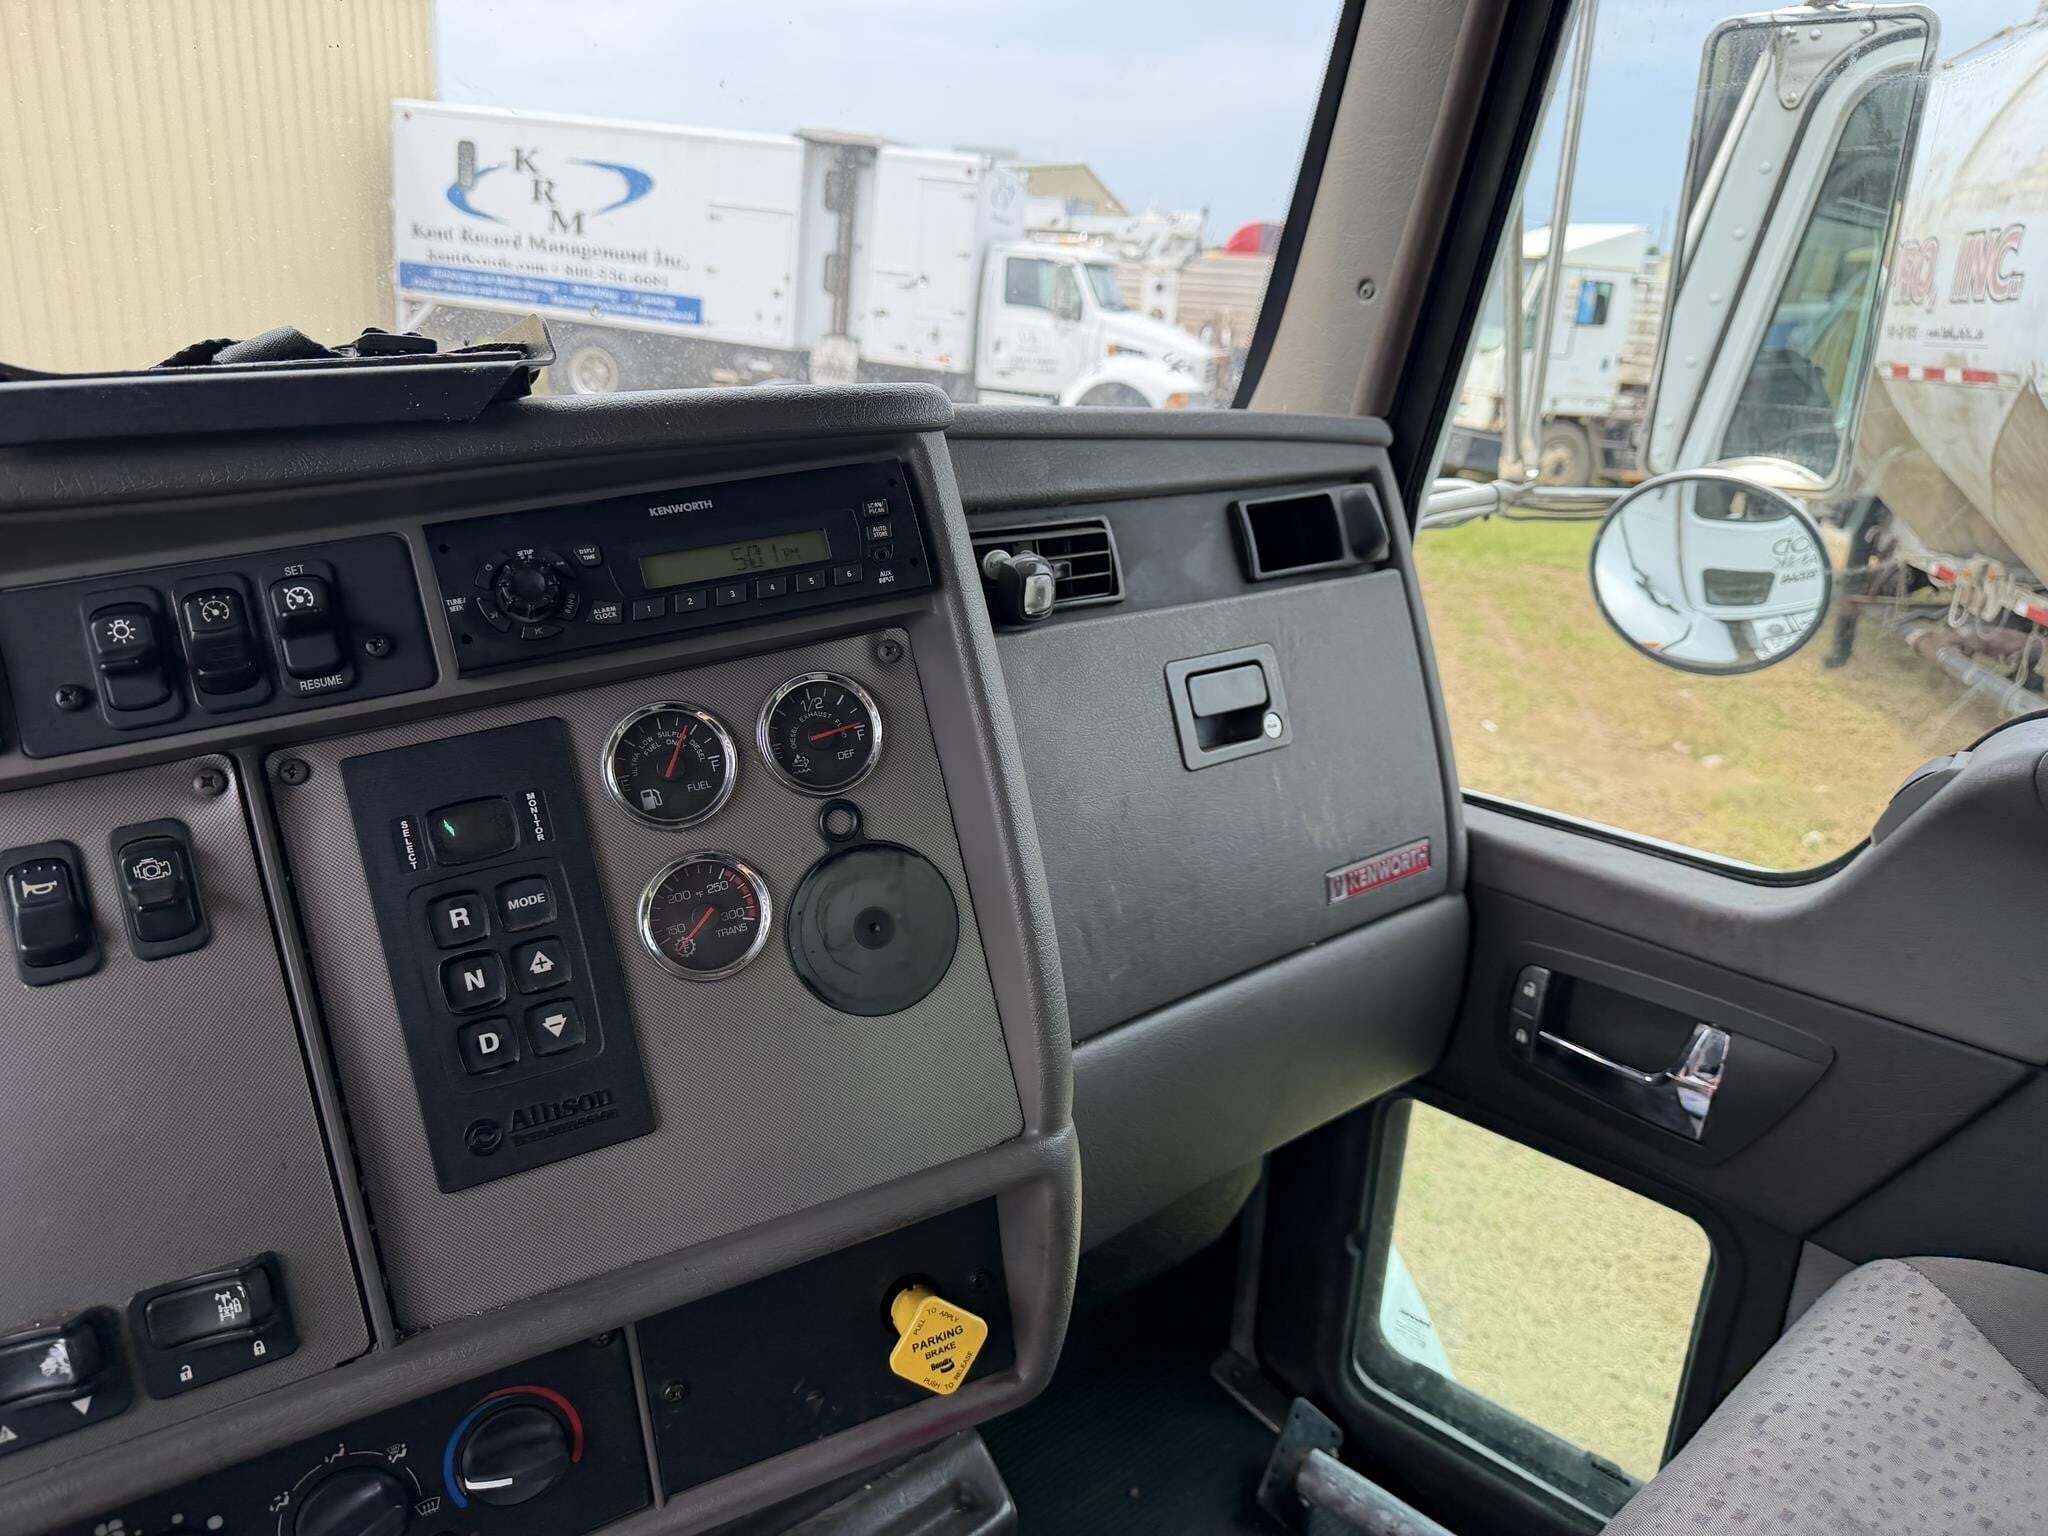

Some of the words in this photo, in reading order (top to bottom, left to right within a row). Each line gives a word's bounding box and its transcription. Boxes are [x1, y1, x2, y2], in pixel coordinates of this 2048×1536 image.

[513, 147, 540, 175] K
[549, 210, 586, 236] M
[649, 499, 713, 517] KENWORTH
[872, 525, 887, 533] AUTO
[517, 549, 534, 557] SETUP
[284, 564, 305, 577] SET
[846, 570, 852, 578] 6
[770, 583, 775, 591] 4
[809, 577, 815, 585] 5
[878, 576, 894, 584] INPUT
[730, 590, 736, 598] 3
[593, 606, 617, 614] ALARM
[595, 612, 617, 621] CLOCK
[300, 674, 344, 692] RESUME
[799, 712, 832, 723] EXHAUST
[856, 729, 865, 741] F
[631, 752, 640, 777] ULTRA
[640, 735, 653, 749] LOW
[688, 740, 706, 762] DIESEL
[644, 741, 662, 756] FUEL
[837, 748, 855, 760] DEF
[711, 760, 721, 772] F
[687, 780, 713, 792] FUEL
[526, 791, 546, 842] MONITOR
[400, 820, 417, 870] SELECT
[1347, 845, 1430, 891] KENWORTH
[667, 889, 692, 904] 200
[706, 880, 730, 895] 250
[508, 892, 546, 911] MODE
[449, 907, 471, 929] R
[720, 907, 745, 922] 300
[715, 923, 748, 938] TRANS
[464, 968, 486, 992] N
[478, 1032, 500, 1054] D
[511, 1087, 613, 1132] Allison
[913, 1319, 926, 1336] PULL
[927, 1307, 937, 1315] TO
[938, 1310, 960, 1322] APPLY
[912, 1325, 964, 1353] PARKING
[925, 1341, 957, 1360] BRAKE
[922, 1377, 941, 1389] PUSH
[944, 1382, 955, 1390] TO
